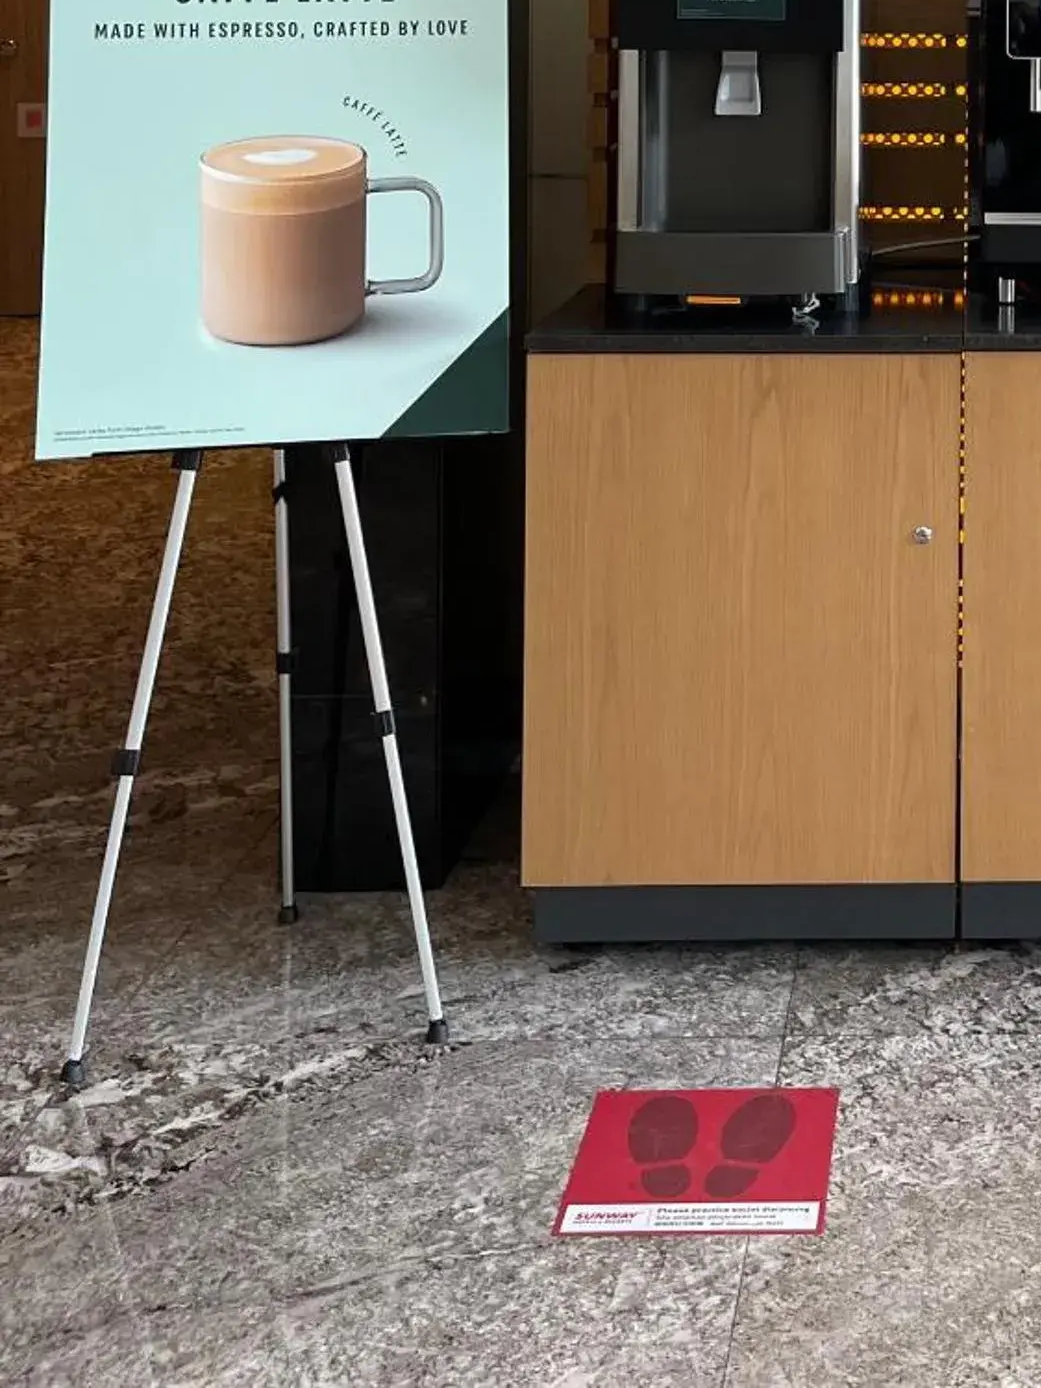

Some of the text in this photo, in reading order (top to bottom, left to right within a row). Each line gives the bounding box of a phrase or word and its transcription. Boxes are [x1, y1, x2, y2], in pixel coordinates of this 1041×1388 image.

[94, 19, 468, 40] MADE WITH ESPRESSO, CRAFTED BY LOVE
[381, 120, 408, 158] LATTE
[575, 1212, 637, 1220] SUNWAY
